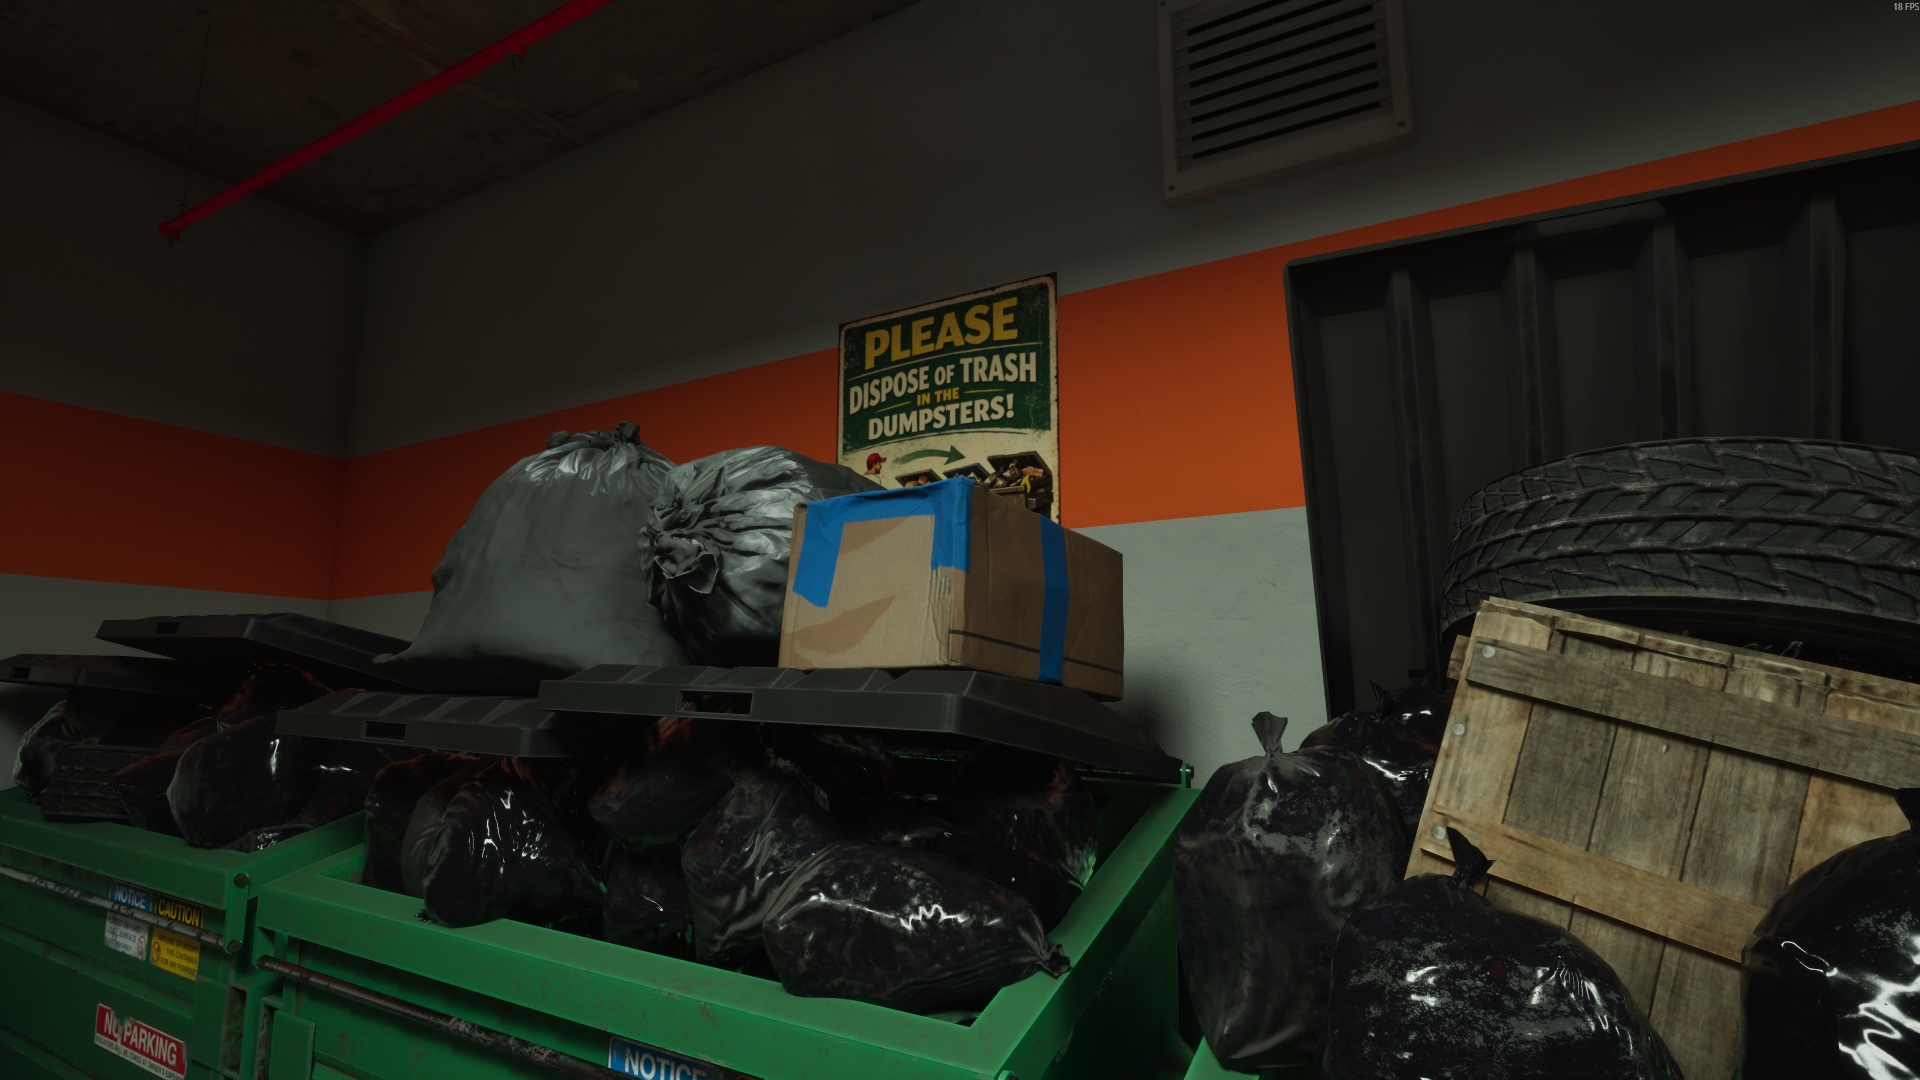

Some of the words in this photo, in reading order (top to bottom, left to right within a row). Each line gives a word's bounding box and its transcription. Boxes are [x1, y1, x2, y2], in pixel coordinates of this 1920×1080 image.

[864, 296, 1019, 371] PLEASE
[849, 365, 930, 416] DISPOSE
[934, 364, 955, 386] OF
[959, 351, 1037, 384] TRASH
[916, 394, 931, 406] IN
[934, 387, 960, 402] THE
[868, 393, 1015, 441] DUMPSTERS!
[115, 886, 147, 910] NOTICE
[158, 899, 200, 928] CAUTION
[119, 930, 137, 944] SURFACE
[160, 957, 169, 966] FOR
[169, 961, 177, 969] ANY
[177, 964, 197, 976] PURPOSE
[166, 948, 175, 957] THIS
[175, 951, 198, 965] CONTAINER
[104, 1012, 119, 1039] NO
[123, 1019, 177, 1067] PARKING
[123, 1048, 129, 1058] BE
[129, 1051, 142, 1064] TOWED
[142, 1058, 148, 1067] AT
